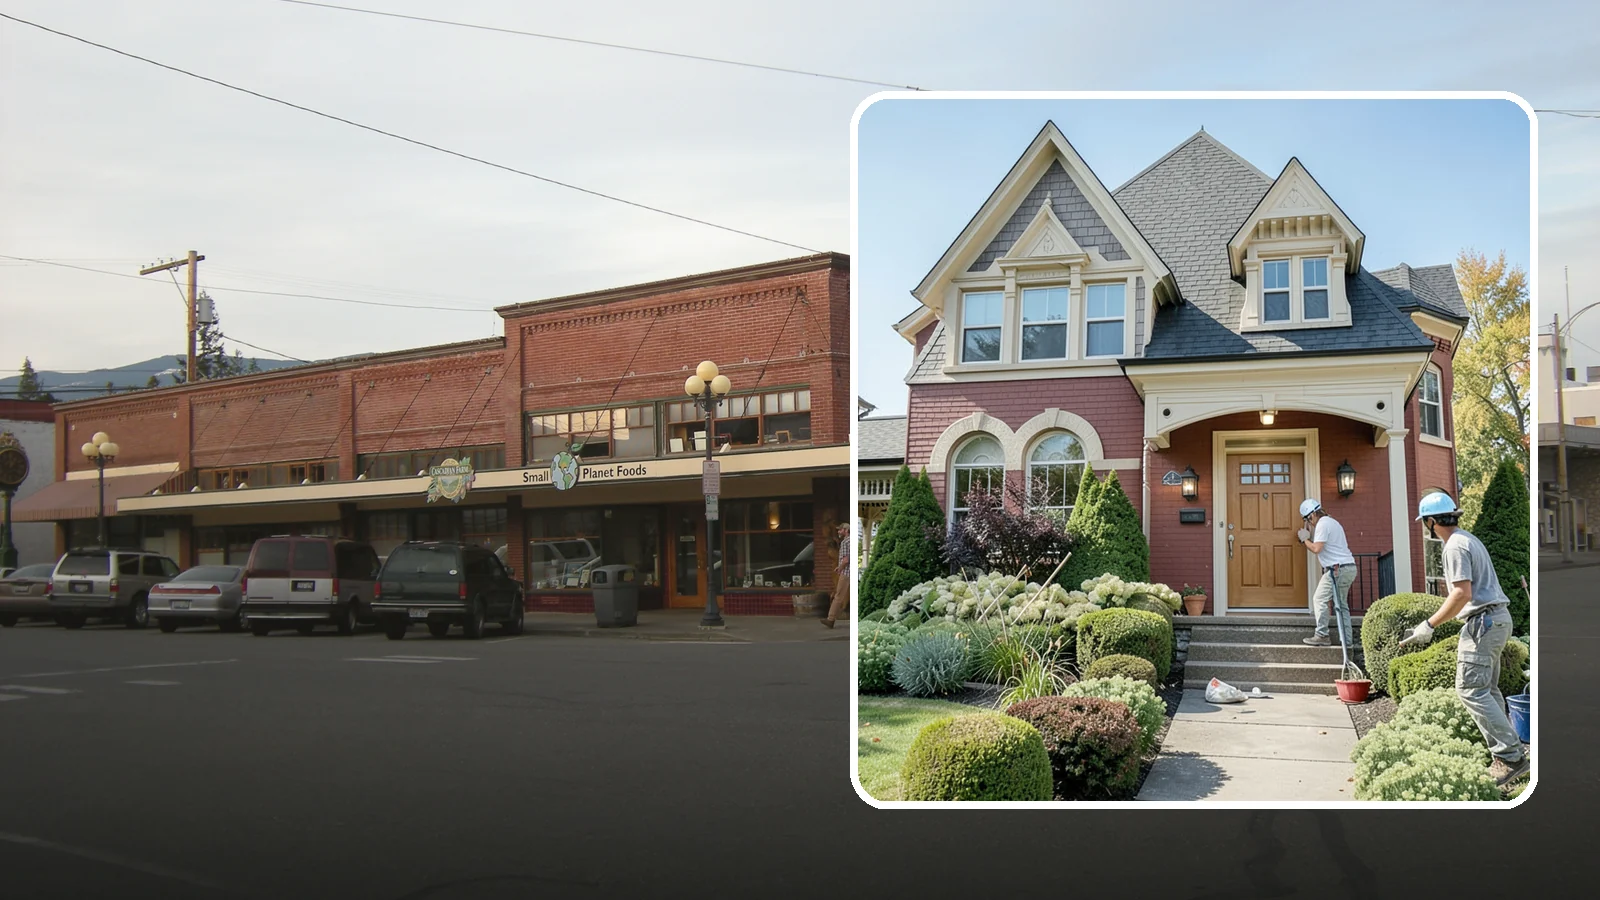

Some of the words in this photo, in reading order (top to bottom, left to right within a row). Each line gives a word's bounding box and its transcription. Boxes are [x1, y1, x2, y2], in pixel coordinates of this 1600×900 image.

[523, 471, 549, 482] Small
[583, 467, 614, 479] Planet
[617, 464, 647, 477] Foods
